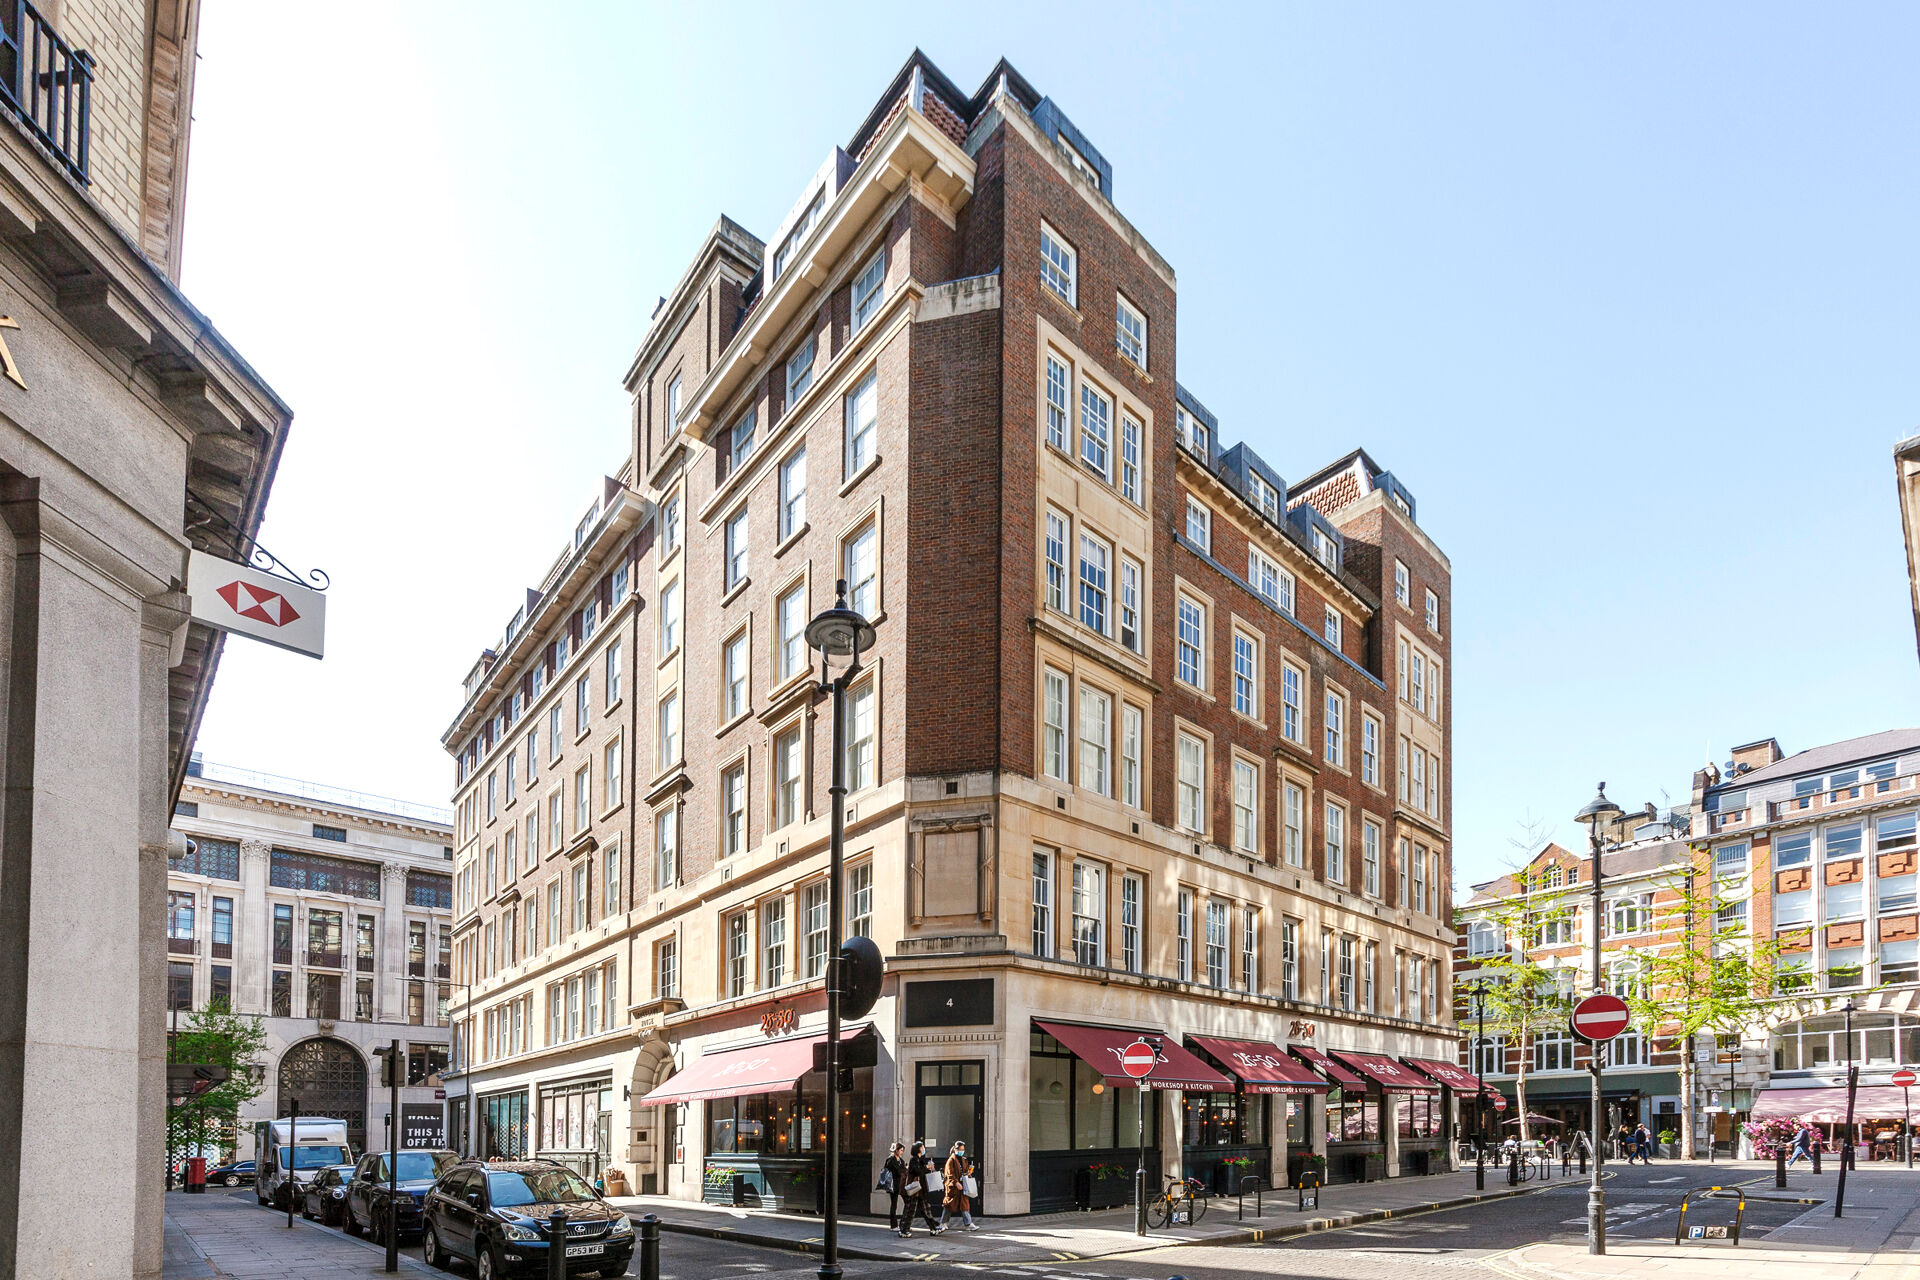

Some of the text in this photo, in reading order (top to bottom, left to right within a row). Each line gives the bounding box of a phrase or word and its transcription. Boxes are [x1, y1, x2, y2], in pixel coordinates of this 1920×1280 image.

[946, 997, 953, 1007] 4
[760, 1008, 794, 1031] 28-50
[1288, 1020, 1315, 1039] 28-50
[1232, 1052, 1280, 1069] 28-50
[1152, 1081, 1183, 1089] WORKSHOP
[407, 1128, 433, 1137] THIS
[406, 1138, 427, 1147] OFF
[1692, 1227, 1702, 1238] P
[567, 1246, 587, 1256] GP53
